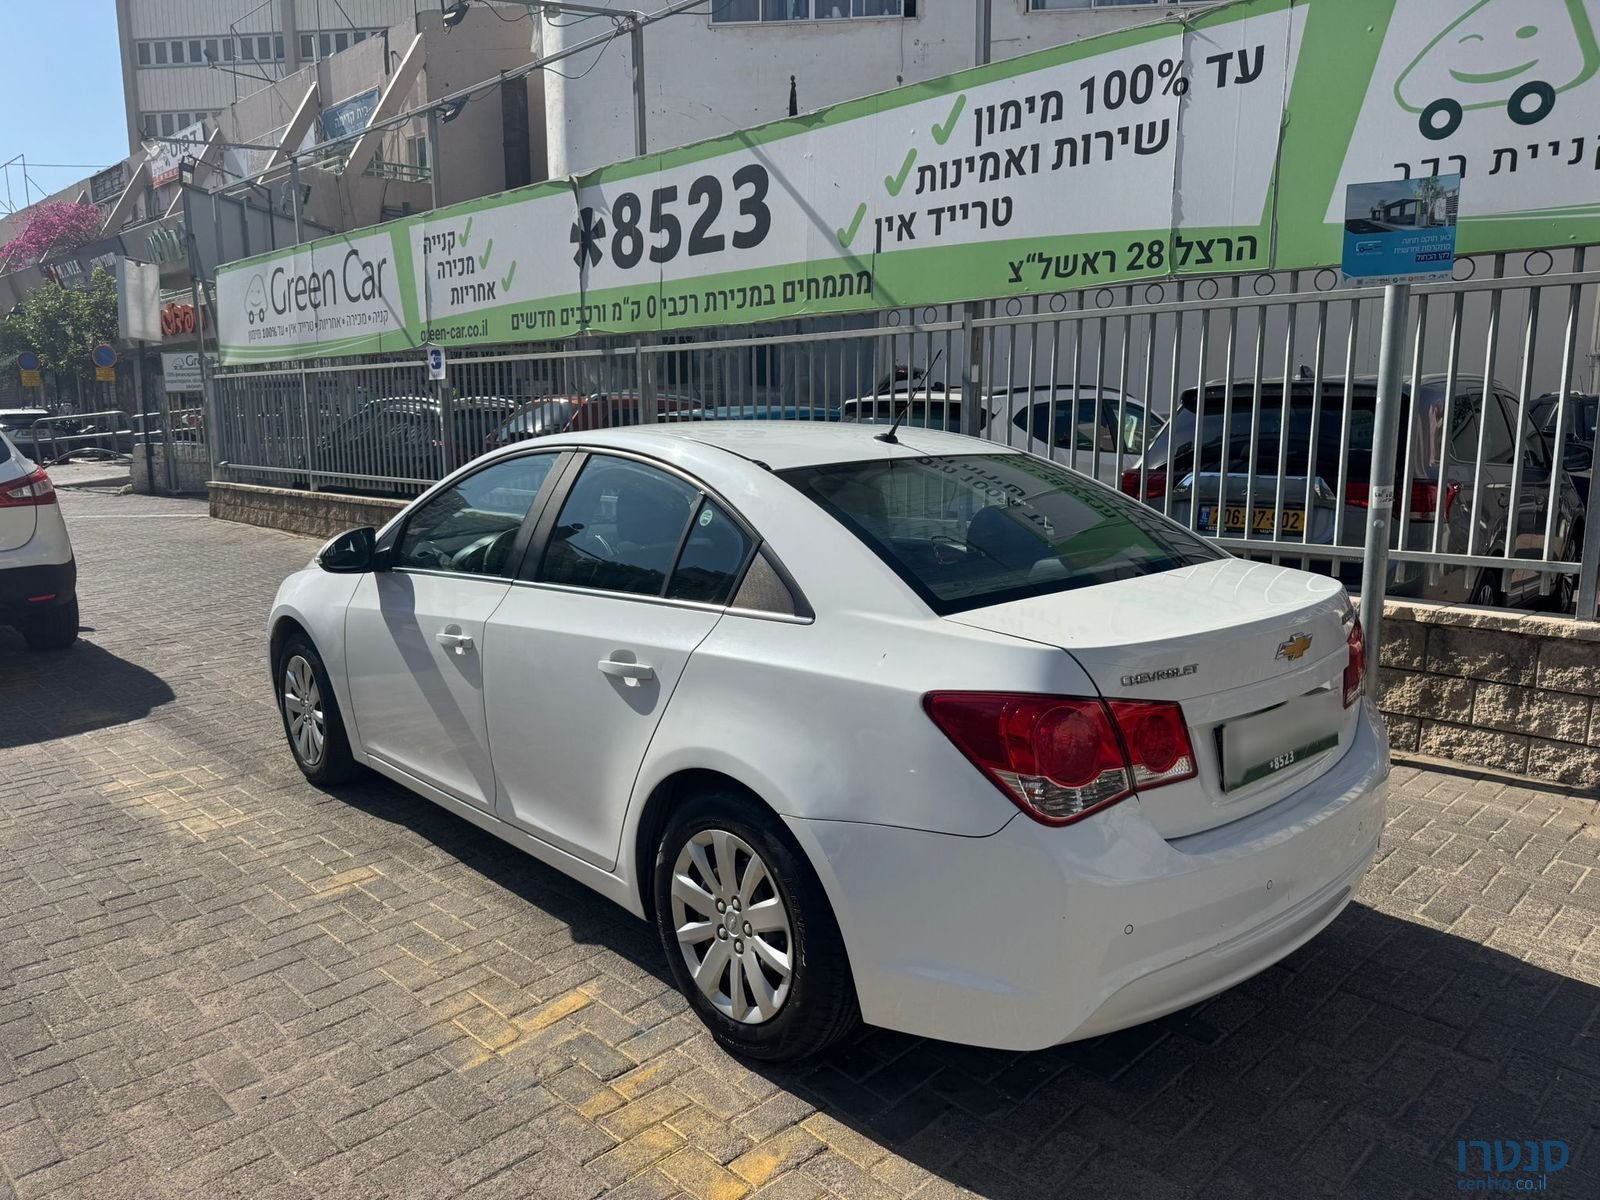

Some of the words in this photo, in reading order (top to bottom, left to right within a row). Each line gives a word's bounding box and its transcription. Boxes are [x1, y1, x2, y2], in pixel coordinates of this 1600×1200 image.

[1205, 45, 1265, 89] עד
[1079, 58, 1189, 115] 100%
[974, 89, 1064, 147] מימון
[1051, 118, 1171, 171] שירות
[915, 143, 1040, 195] ואמינות
[927, 195, 1013, 236] טרייד
[423, 231, 456, 256] קנייה
[874, 211, 917, 254] אין
[1126, 239, 1165, 271] 28
[1175, 235, 1258, 266] הרצל
[270, 266, 337, 315] Green
[343, 248, 387, 303] Car
[437, 255, 475, 280] מכירה
[450, 281, 496, 306] אחריות
[704, 284, 776, 313] במכירת
[783, 270, 872, 304] מתמחים
[346, 313, 367, 327] מכירה
[372, 310, 388, 326] קניה
[511, 310, 556, 330] חדשים
[560, 304, 606, 326] ורכבים
[647, 295, 657, 319] 0
[661, 294, 698, 317] רכבי
[318, 316, 341, 331] אחריות
[1120, 663, 1199, 688] CHEVROLET
